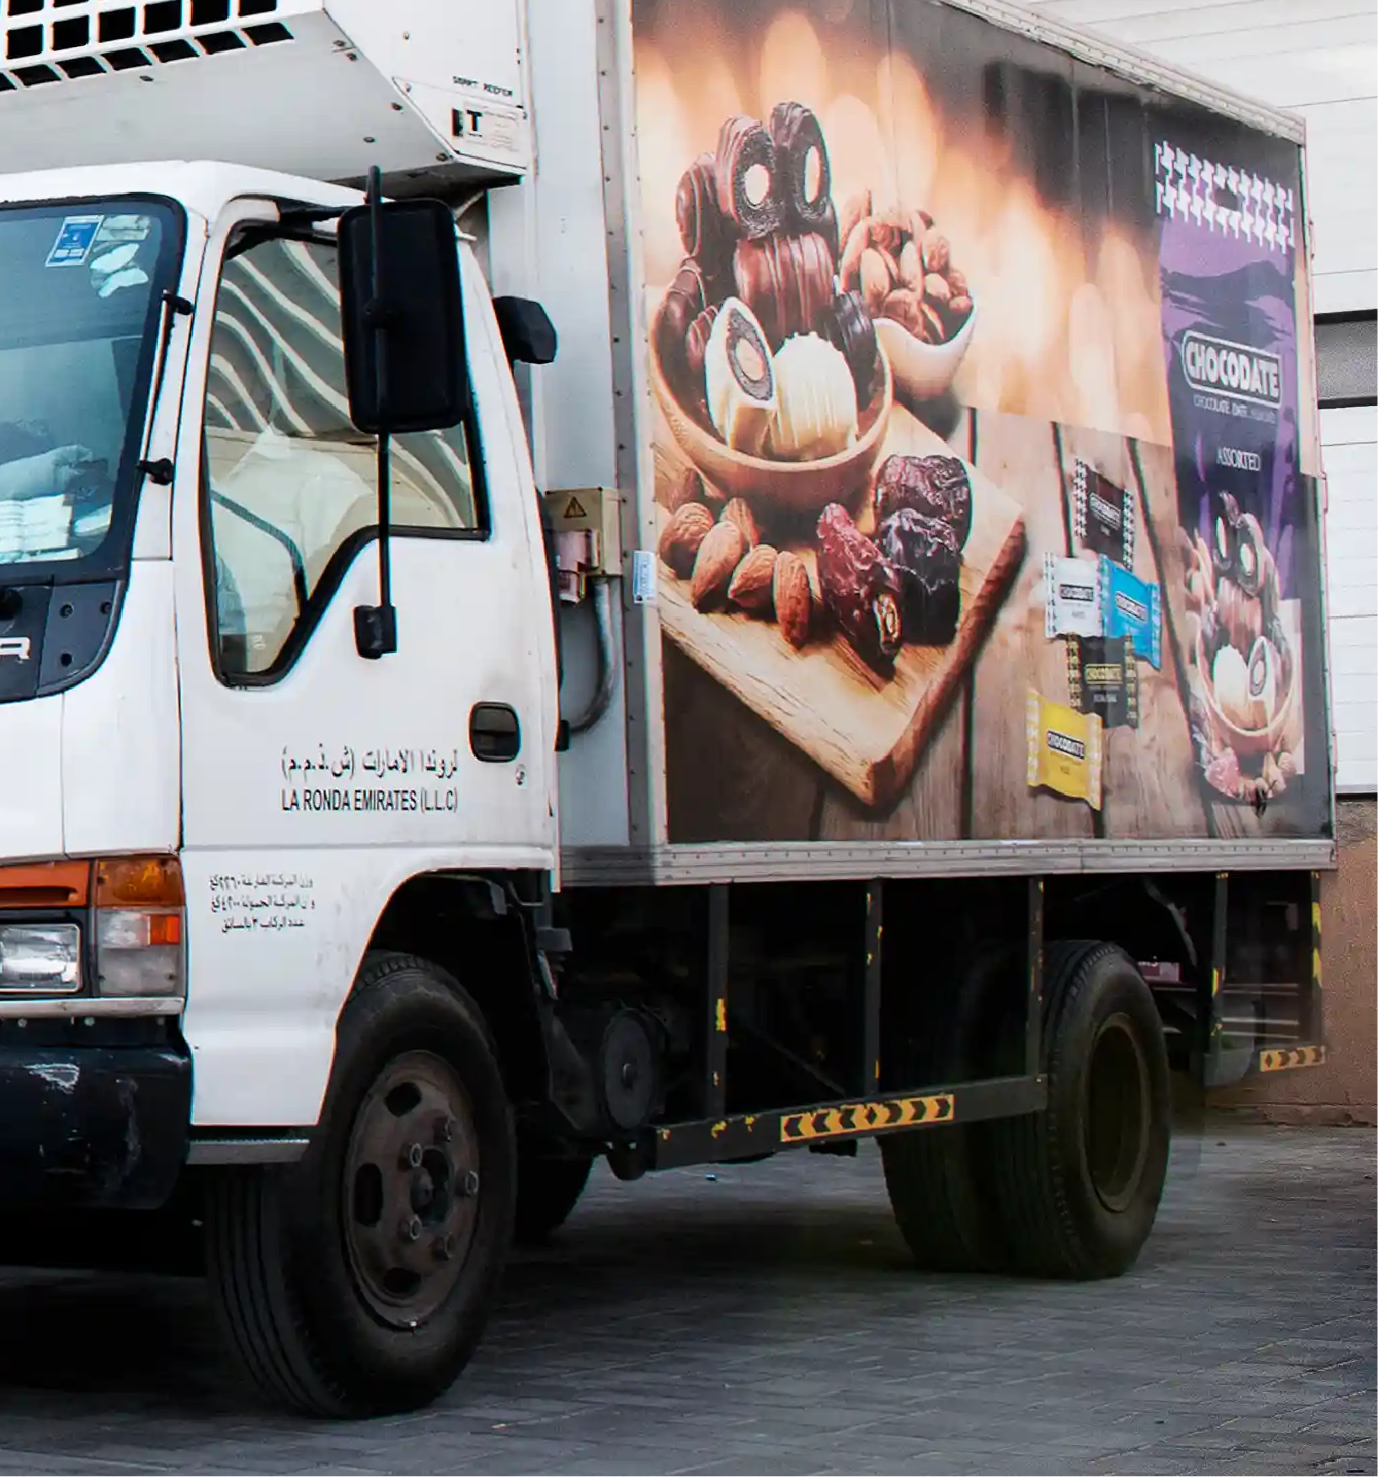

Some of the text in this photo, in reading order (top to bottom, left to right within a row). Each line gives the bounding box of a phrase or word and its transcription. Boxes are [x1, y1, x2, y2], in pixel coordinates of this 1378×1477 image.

[1184, 340, 1280, 398] CHOCODATE
[1216, 446, 1261, 472] ASSORTED
[281, 789, 300, 812] LA
[303, 789, 351, 812] RONDA
[354, 789, 417, 811] EMIRATES
